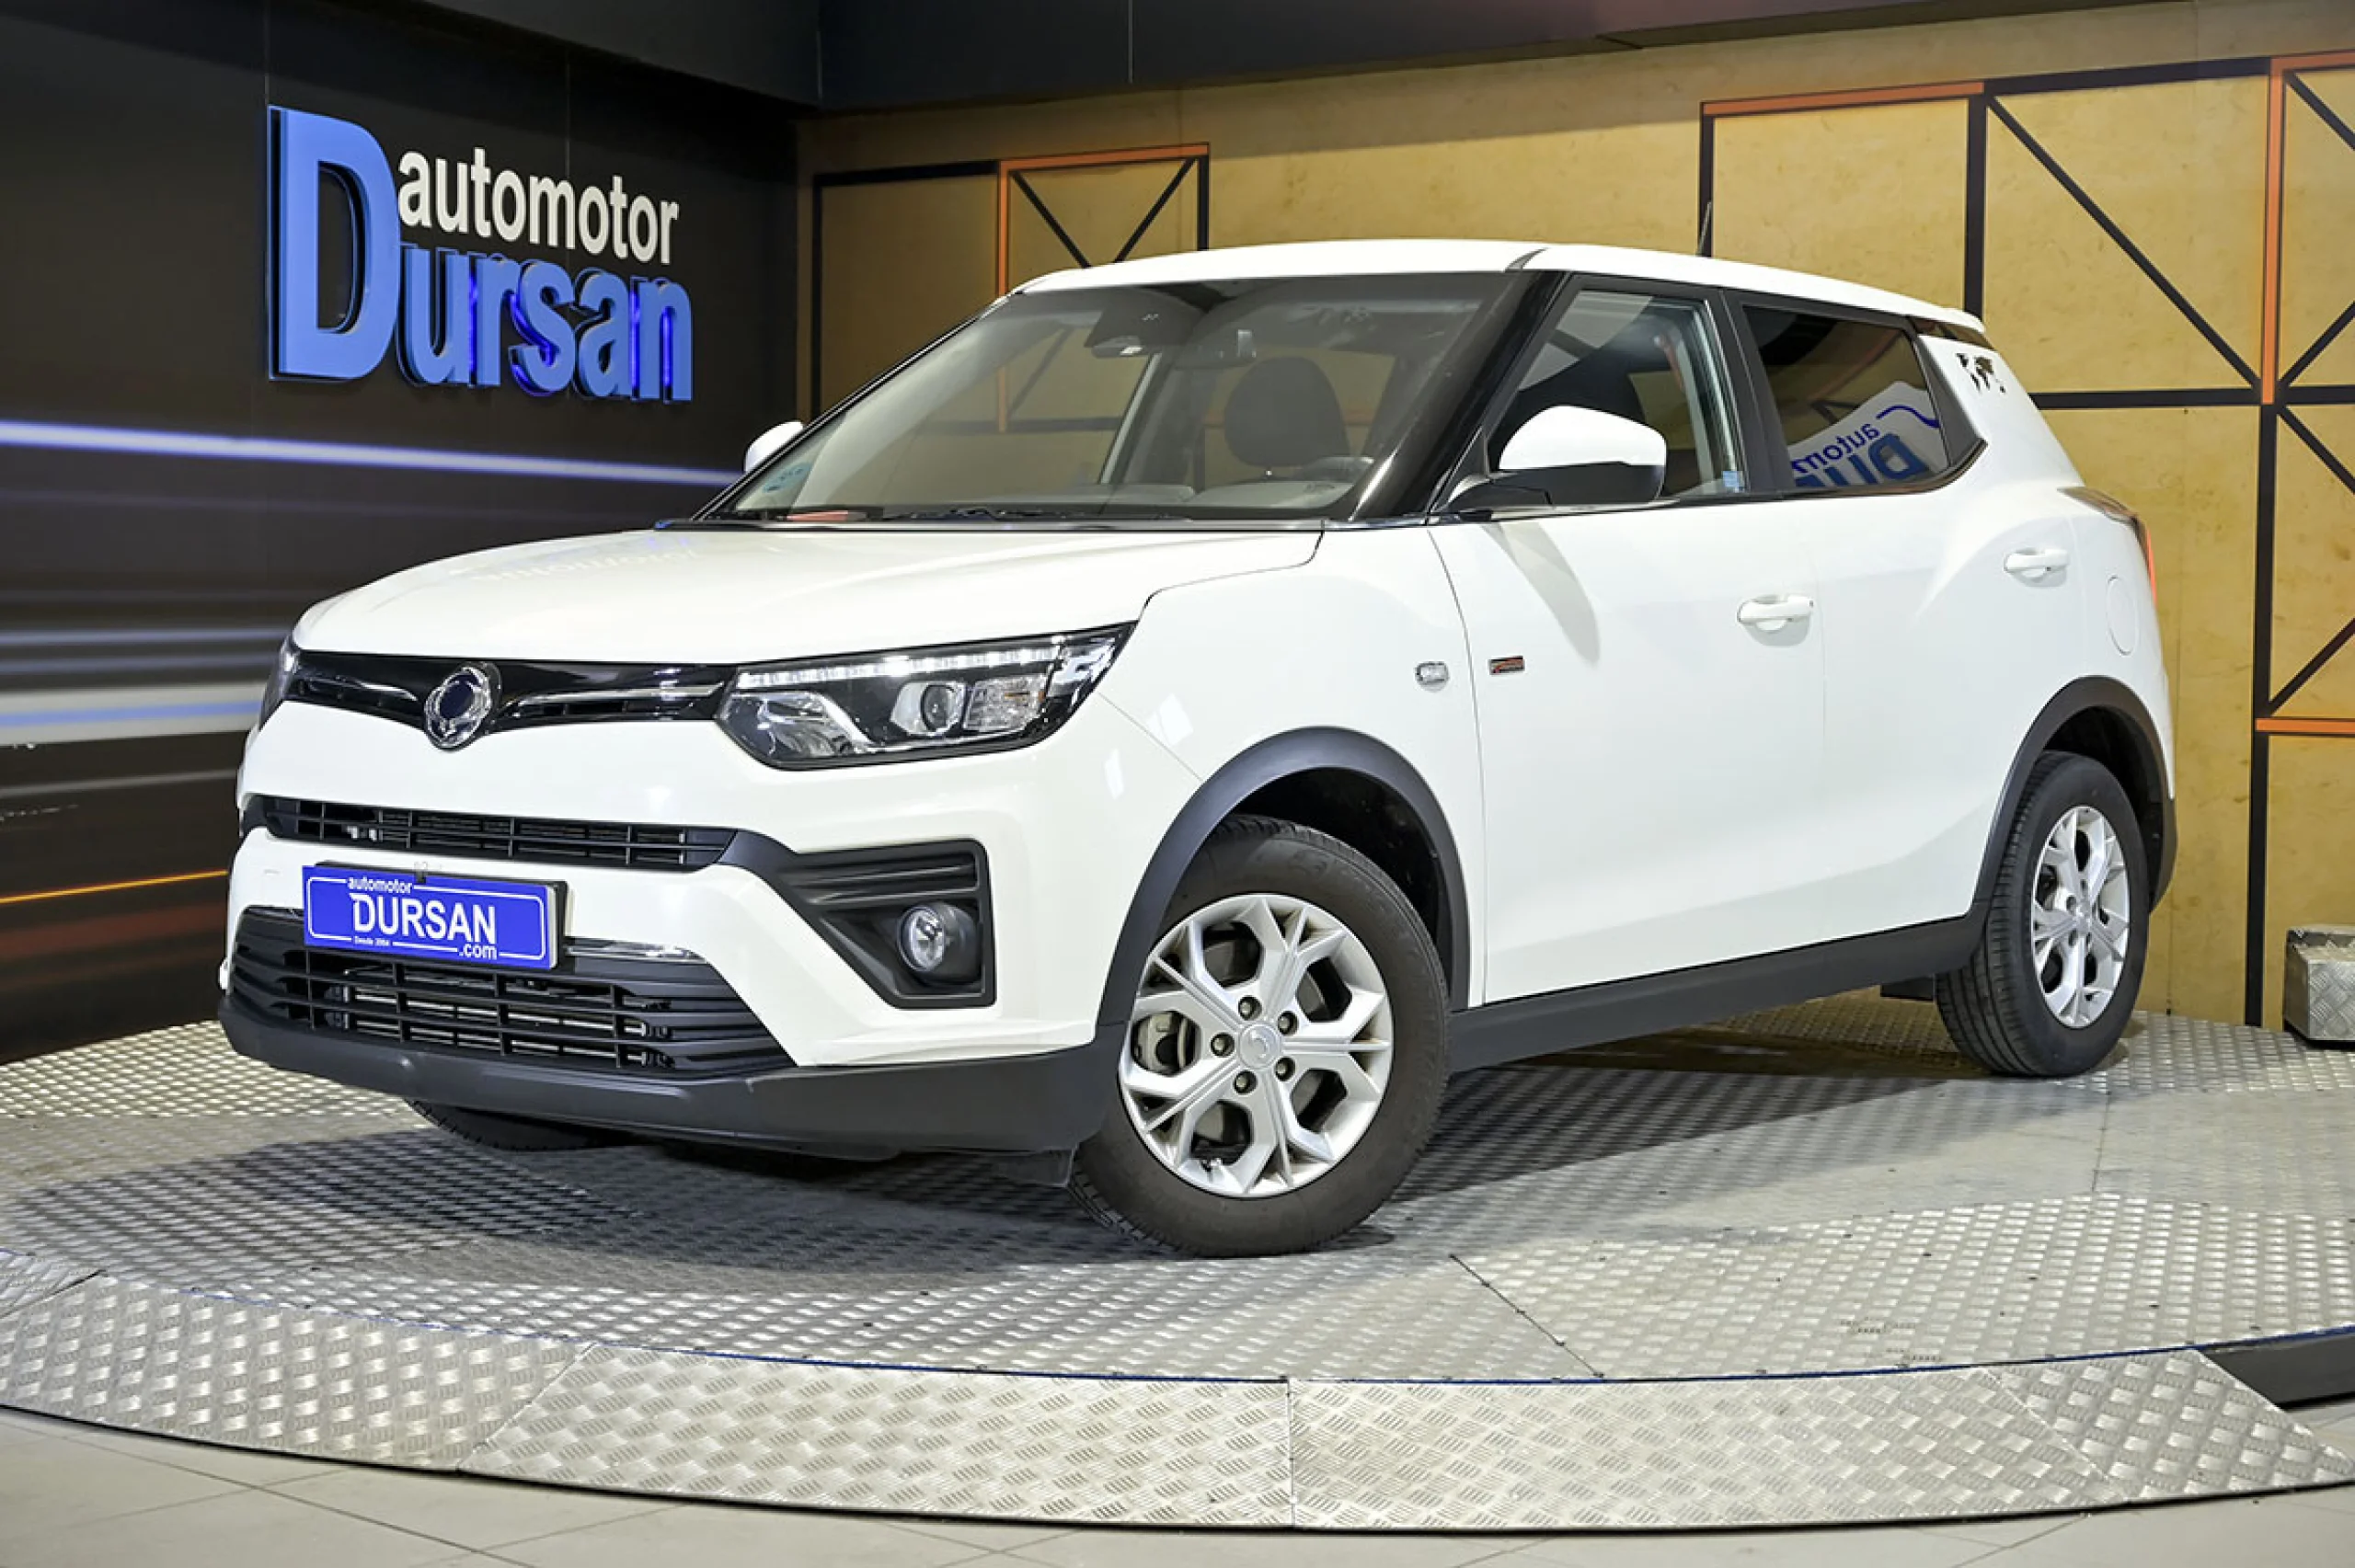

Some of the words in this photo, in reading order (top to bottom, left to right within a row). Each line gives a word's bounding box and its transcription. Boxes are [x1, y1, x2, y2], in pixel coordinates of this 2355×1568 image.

[398, 146, 679, 263] automotor
[268, 104, 693, 403] Dursan
[347, 876, 413, 894] automotor
[349, 892, 497, 944] DURSAN
[458, 942, 498, 960] .com
